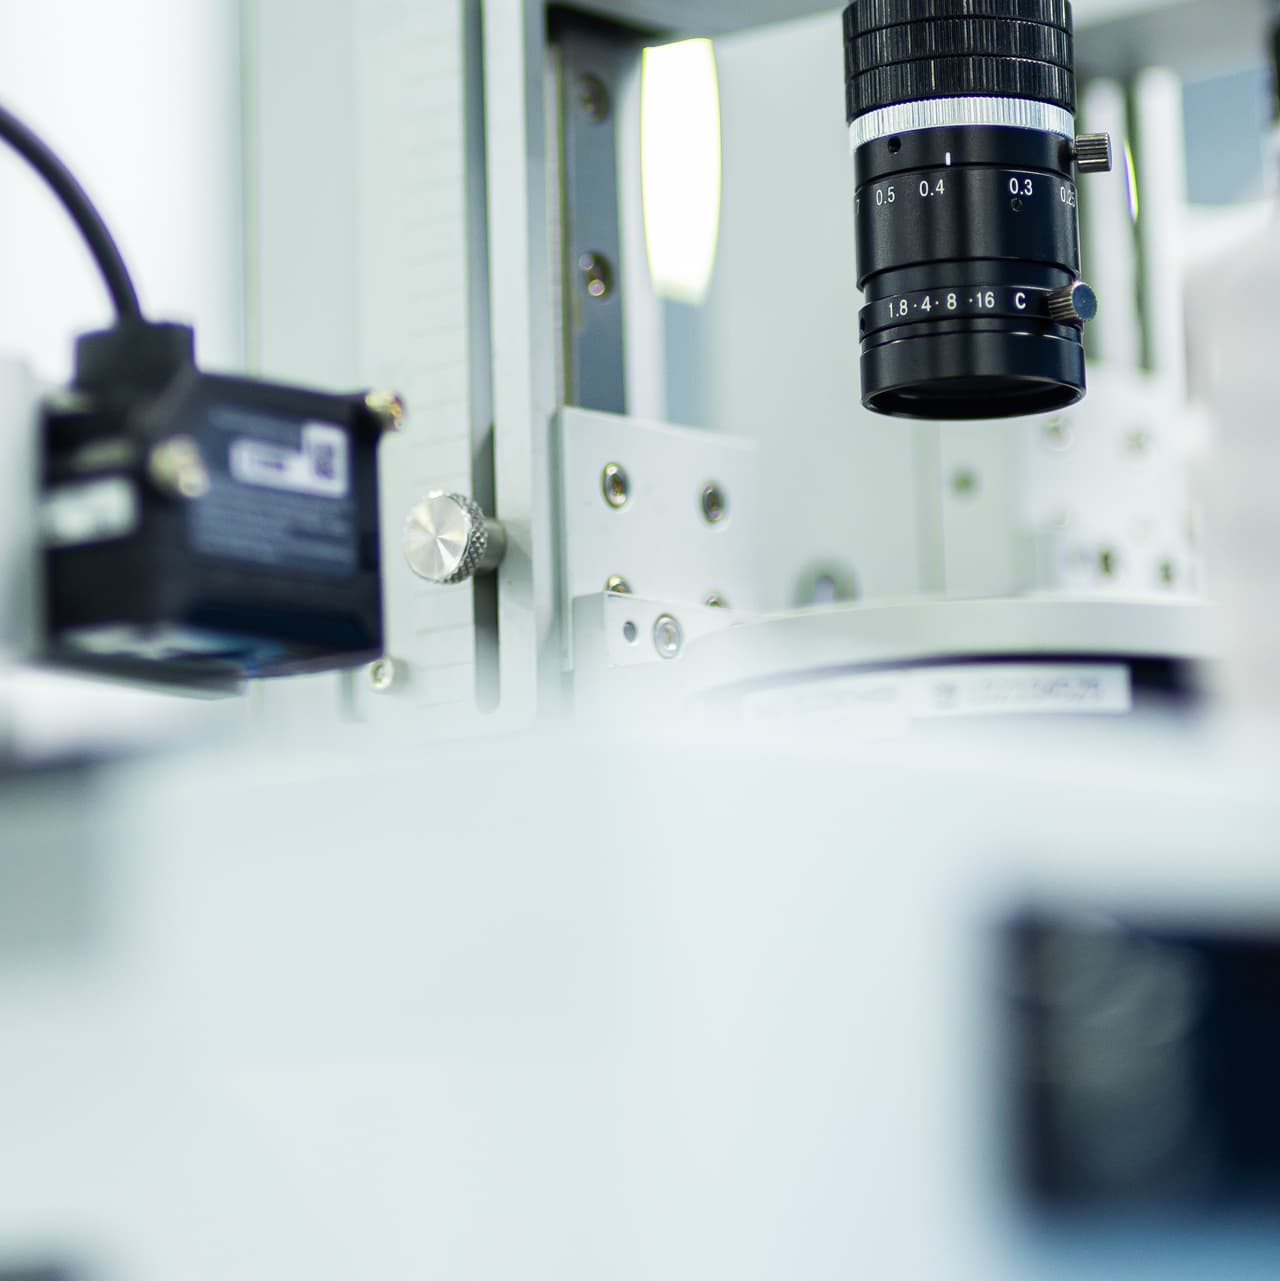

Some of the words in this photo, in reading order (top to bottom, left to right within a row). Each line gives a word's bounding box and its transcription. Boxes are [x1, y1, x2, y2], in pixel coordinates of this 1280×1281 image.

[875, 186, 896, 206] 0.5
[919, 179, 945, 197] 0.4
[1009, 177, 1033, 196] 0.3
[888, 299, 908, 318] 1.8
[946, 292, 957, 309] 8
[1015, 292, 1027, 310] C
